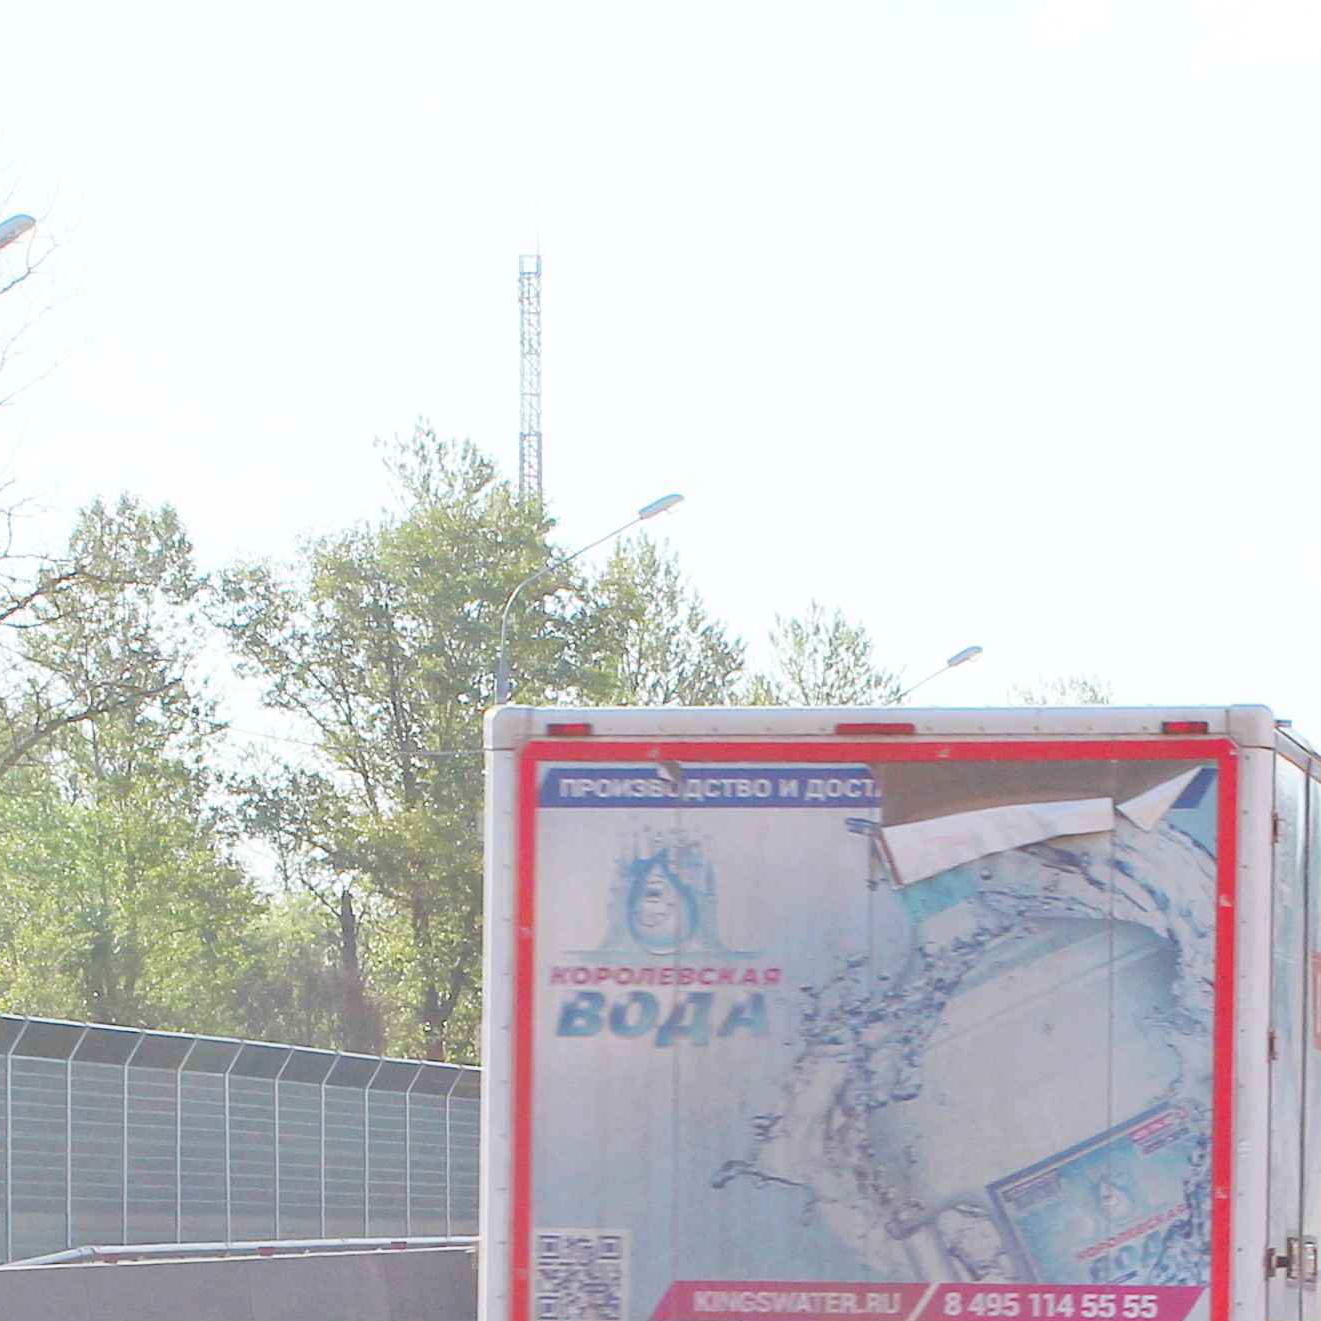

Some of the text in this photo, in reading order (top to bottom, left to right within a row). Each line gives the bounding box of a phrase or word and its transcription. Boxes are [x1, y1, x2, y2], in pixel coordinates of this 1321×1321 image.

[779, 778, 799, 798] И
[804, 778, 882, 802] ДОСТ
[550, 967, 782, 986] КОРОЛЕВСКАЯ
[555, 990, 770, 1048] ВОДА
[692, 1290, 1159, 1319] KINGSWATER.RU 8 495 114 55 55
